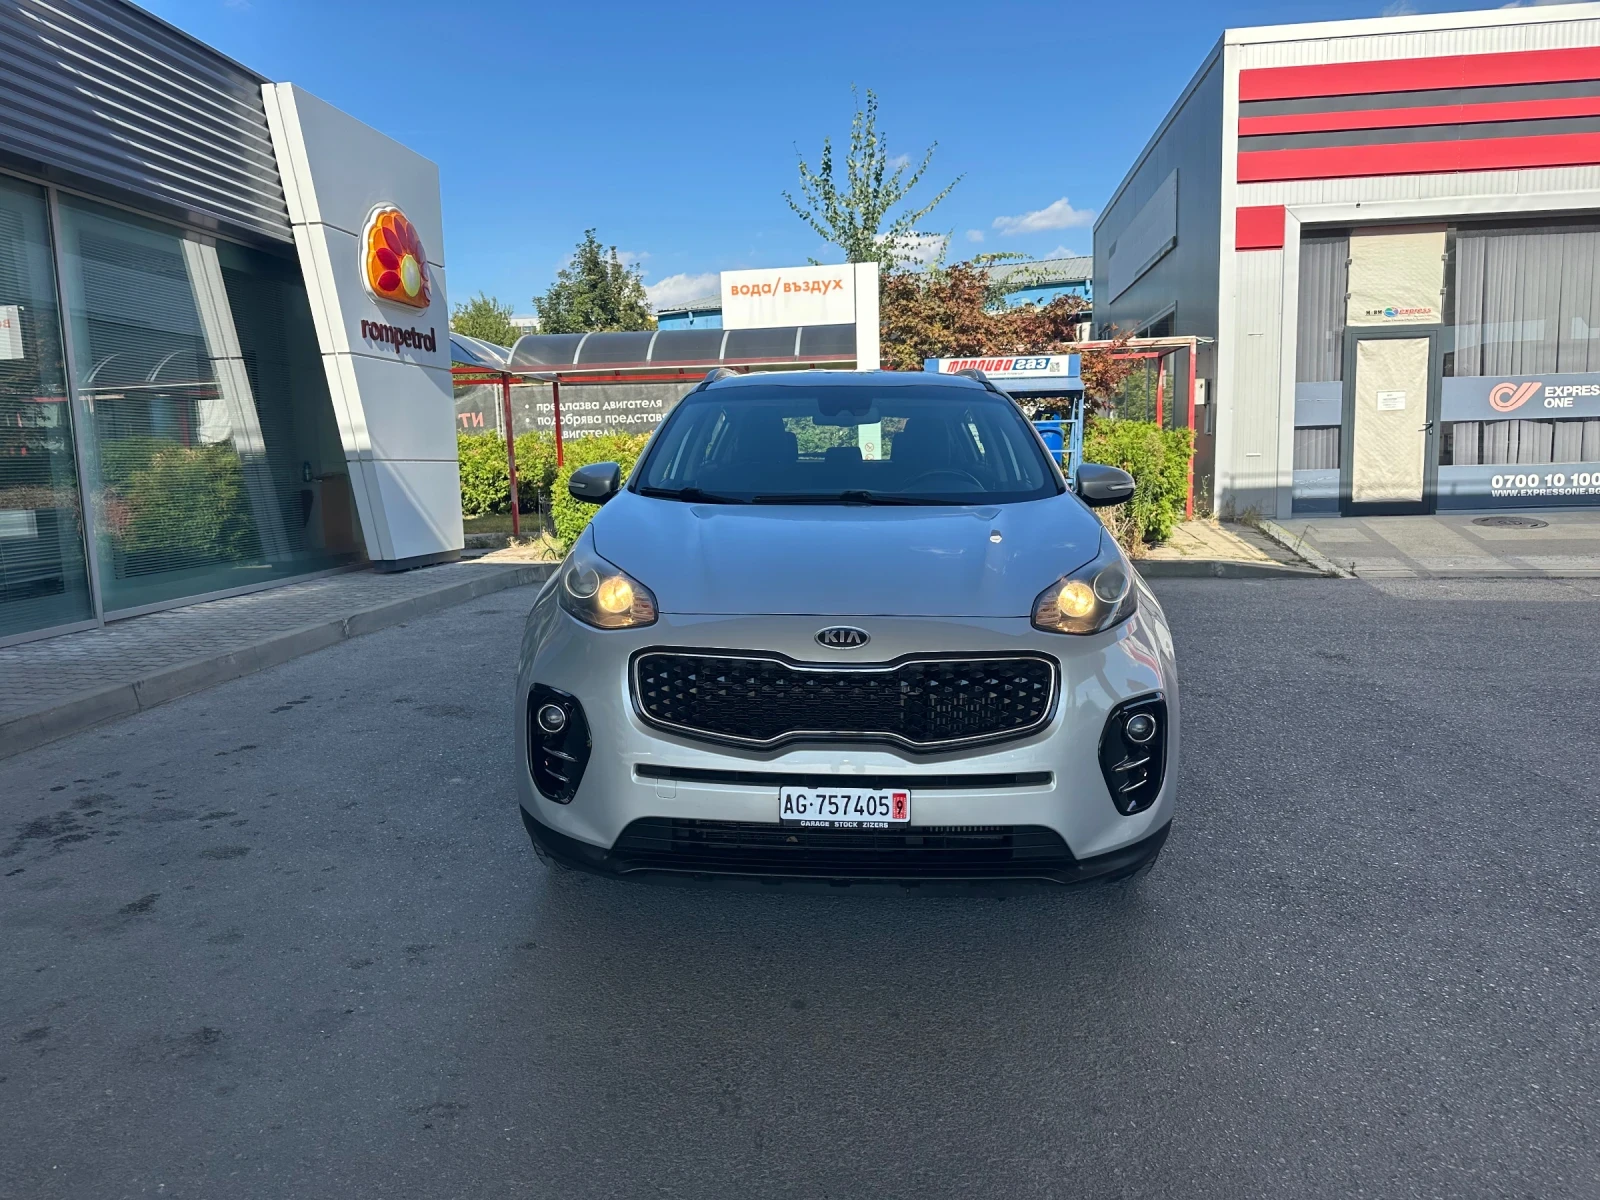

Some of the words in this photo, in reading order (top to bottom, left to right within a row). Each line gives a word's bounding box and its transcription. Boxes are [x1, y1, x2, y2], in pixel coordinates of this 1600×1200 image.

[731, 277, 843, 297] вода/въздух
[361, 319, 437, 354] rompetrol
[602, 399, 663, 411] двигателя
[1543, 398, 1574, 408] ONE
[561, 429, 616, 439] вигателя
[1491, 474, 1540, 489] 0700
[1544, 473, 1566, 487] 10
[1570, 472, 1600, 486] 100
[1491, 487, 1600, 497] WWW.EXPRESSONE.BG
[824, 630, 861, 643] KIA
